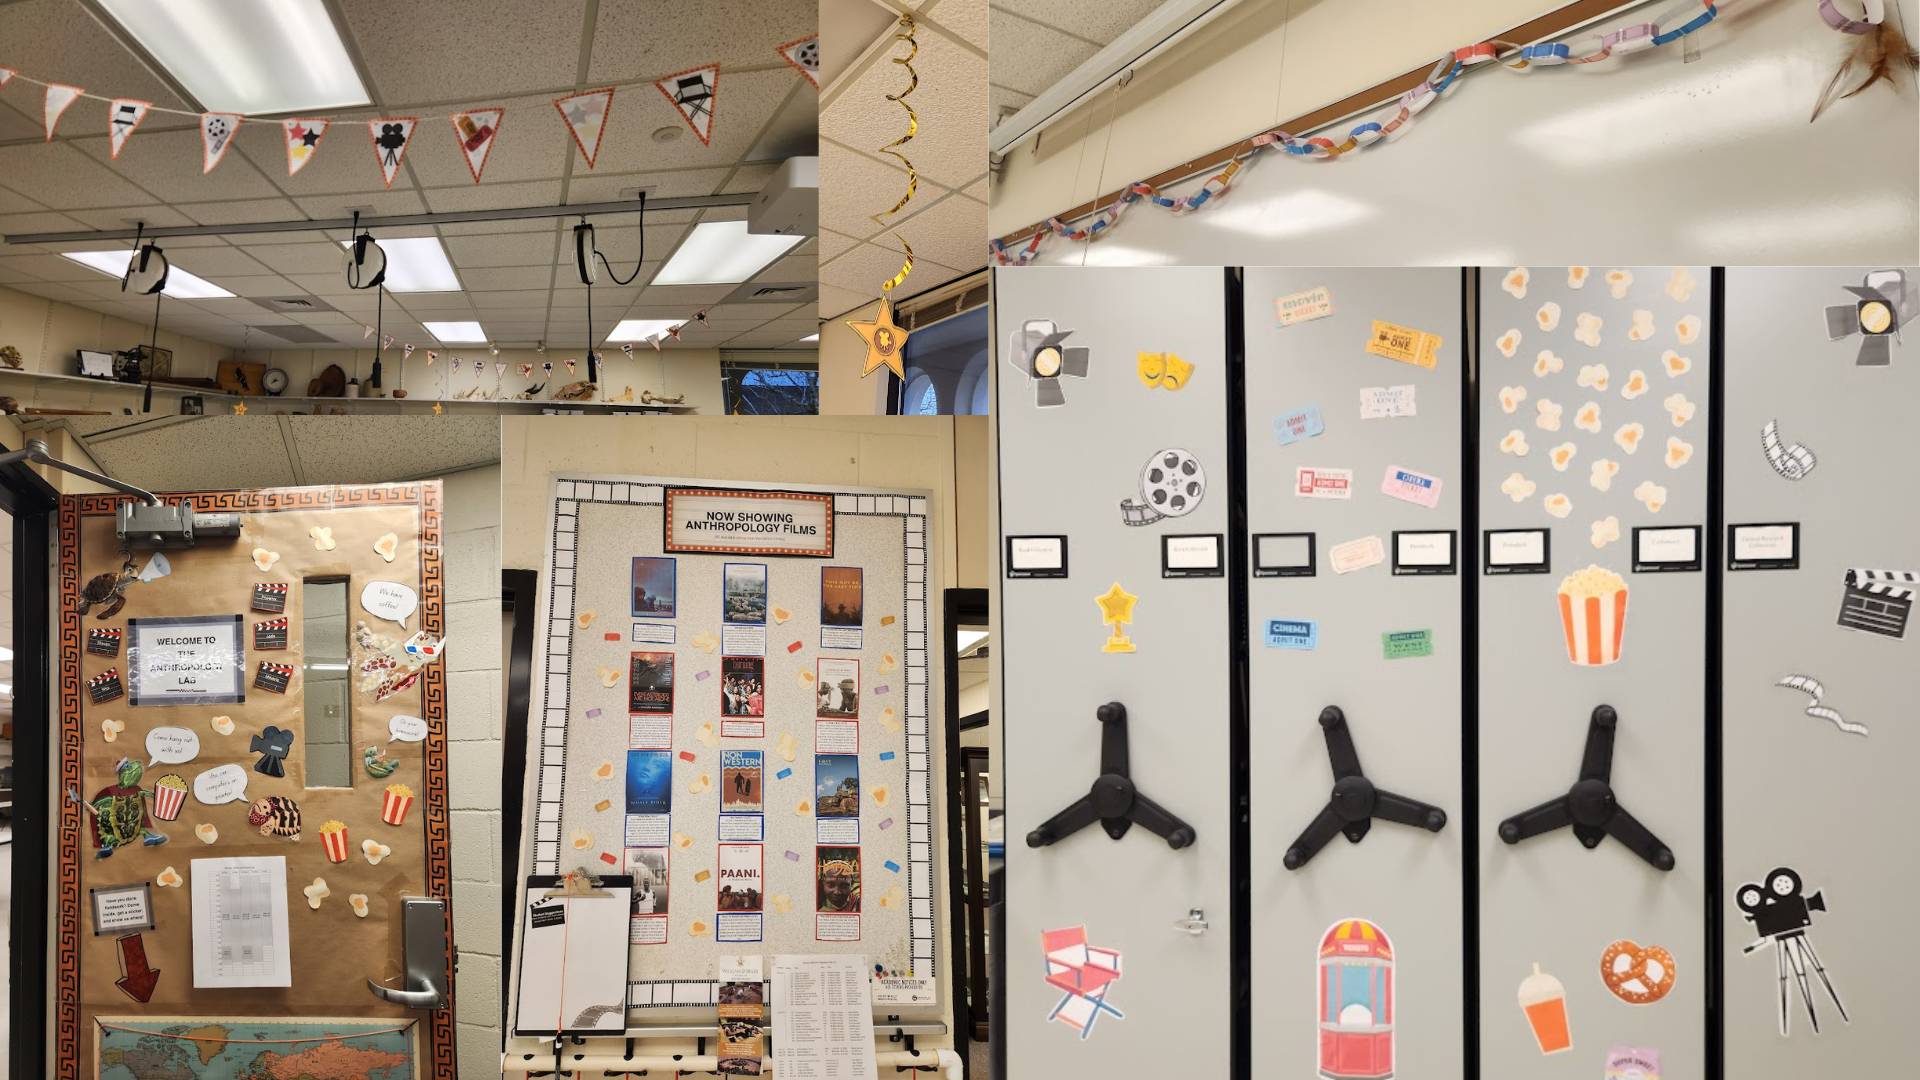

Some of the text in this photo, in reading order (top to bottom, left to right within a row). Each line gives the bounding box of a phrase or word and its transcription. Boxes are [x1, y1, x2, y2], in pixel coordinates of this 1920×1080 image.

[1390, 339, 1411, 351] ONE
[707, 511, 793, 523] NOW SHOWING
[686, 521, 816, 535] ANTHROPOLOGY FILMS
[1272, 623, 1308, 634] CINEMA
[157, 636, 216, 645] WELCOME TO
[168, 734, 182, 746] hang
[723, 751, 742, 760] NON
[723, 759, 761, 767] WESTERN
[720, 869, 761, 878] PAANI.
